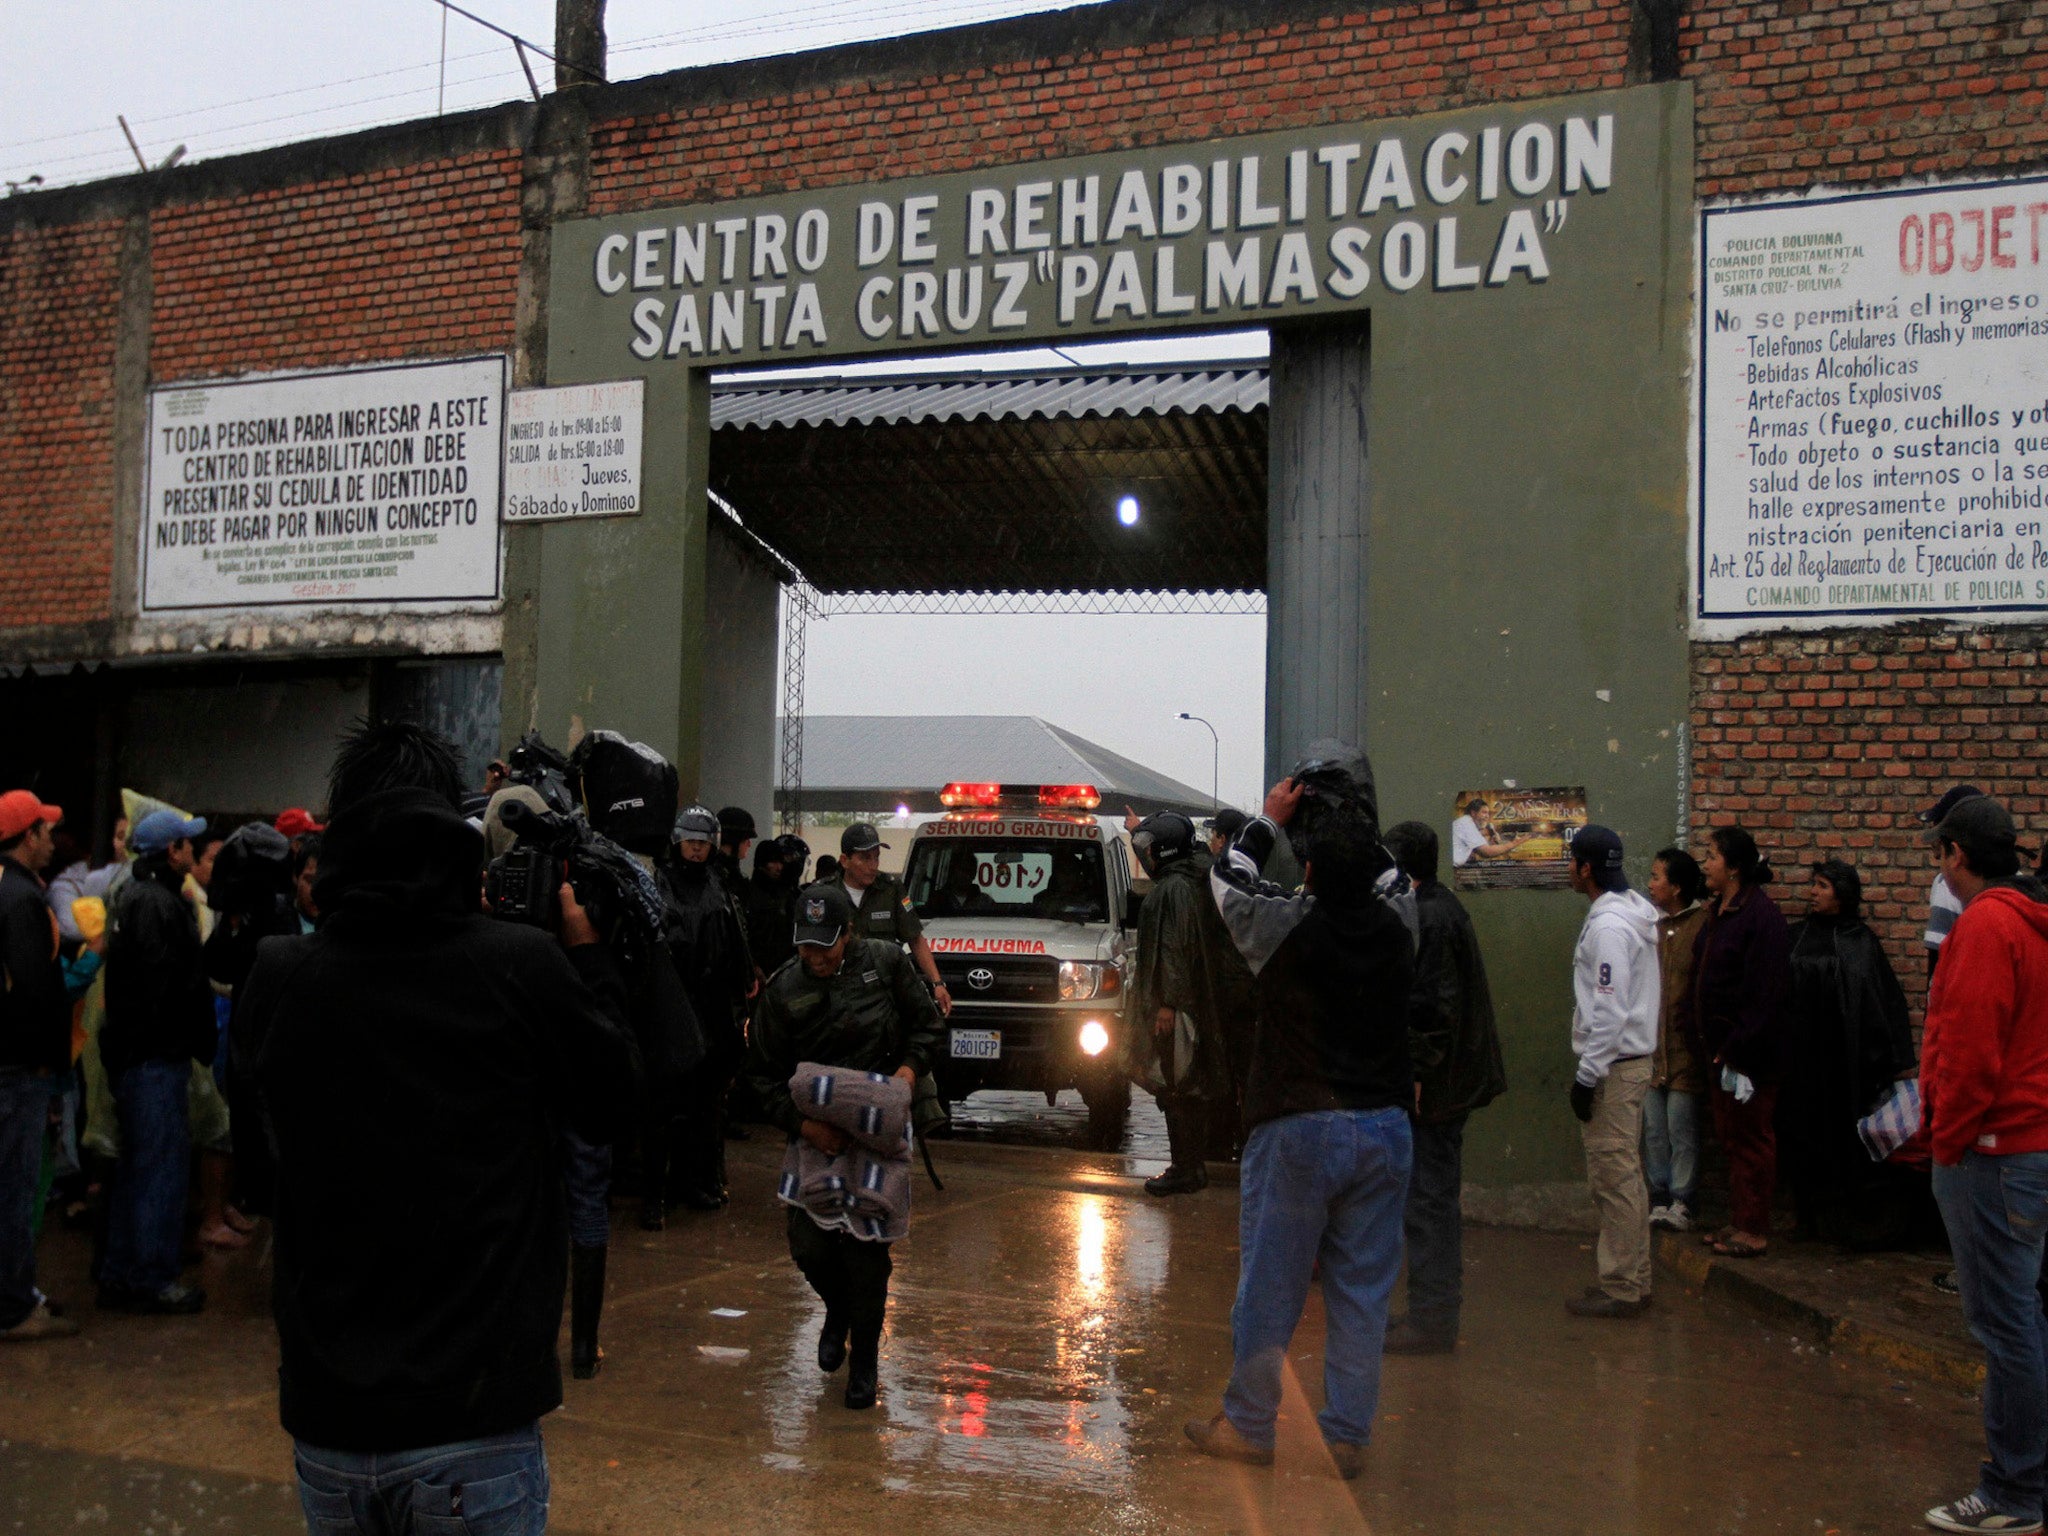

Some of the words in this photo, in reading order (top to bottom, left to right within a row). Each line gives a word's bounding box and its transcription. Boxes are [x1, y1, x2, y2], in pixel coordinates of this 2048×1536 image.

[596, 208, 829, 294] CENTRO
[858, 196, 938, 268] DE
[968, 115, 1613, 257] REHABILITACION
[1709, 254, 1764, 269] COMANDO
[1770, 246, 1865, 265] DEPARTAMENTAL
[1727, 238, 1776, 252] POLICIA
[1782, 232, 1843, 249] BOLIVIANA
[1714, 268, 1763, 284] DISTRITO
[1768, 264, 1812, 279] POLICIAL
[1841, 262, 1849, 274] 2
[1723, 282, 1757, 297] SANTA
[1797, 277, 1842, 293] BOLIVIA
[630, 282, 827, 358] SANTA
[857, 261, 1029, 339] CRUZ
[1714, 309, 1741, 333] No
[1755, 311, 1784, 327] se
[1794, 297, 1898, 329] permitirá
[1910, 293, 1930, 318] el
[1940, 293, 2039, 323] ingreso
[1748, 335, 1822, 358] Telefonos
[1829, 328, 1895, 352] Celulares
[1904, 322, 1950, 347] (Flash
[1954, 326, 1965, 347] y
[1747, 364, 1808, 384] Bebidas
[1816, 354, 1919, 380] Alcohólicas
[1748, 387, 1840, 410] Artefactos
[1849, 383, 1942, 409] Explosivos
[162, 425, 211, 455] TODA
[218, 418, 289, 449] PERSONA
[294, 413, 333, 442] PARA
[338, 402, 421, 437] INGRESAR
[428, 402, 442, 430] A
[446, 396, 489, 428] ESTE
[511, 421, 544, 440] INGRESO
[549, 421, 558, 437] de
[595, 423, 600, 433] a
[1748, 416, 1808, 439] Armas
[1904, 406, 2000, 431] cuchillos
[2011, 411, 2024, 429] y
[184, 456, 248, 484] CENTRO
[254, 453, 272, 478] DE
[276, 437, 414, 476] REHABILITACION
[425, 431, 467, 463] DEBE
[509, 444, 540, 463] SALIDA
[548, 444, 558, 460] de
[597, 446, 601, 457] a
[1748, 443, 1788, 467] Todo
[1798, 440, 1859, 467] objeto
[1872, 446, 1883, 460] o
[1894, 434, 2000, 459] sustancia
[162, 485, 249, 515] PRESENTAR
[254, 482, 273, 508] SU
[279, 477, 341, 506] CEDULA
[346, 475, 365, 500] DE
[372, 466, 468, 499] IDENTIDAD
[1749, 470, 1799, 493] salud
[1808, 470, 1829, 490] de
[1836, 467, 1863, 489] los
[1874, 466, 1960, 488] internos
[1972, 467, 1984, 482] o
[1995, 459, 2013, 481] la
[509, 494, 568, 516] Sábado
[572, 503, 579, 515] y
[1749, 497, 1792, 520] halle
[1802, 491, 1946, 521] expresamente
[157, 521, 179, 549] NO
[182, 517, 217, 545] DEBE
[223, 512, 271, 542] PAGAR
[277, 511, 308, 539] POR
[315, 506, 379, 536] NINGUN
[387, 498, 477, 530] CONCEPTO
[1748, 522, 1851, 546] nistración
[1864, 518, 2003, 551] penitenciaria
[2016, 521, 2040, 537] en
[1709, 553, 1739, 578] Art.
[1745, 551, 1764, 577] 25
[1771, 552, 1792, 576] del
[1798, 550, 1881, 582] Reglamento
[1888, 550, 1906, 574] de
[1916, 544, 1996, 577] Ejecución
[2006, 543, 2024, 570] de
[1746, 586, 1820, 606] COMANDO
[1828, 583, 1934, 604] DEPARTAMENTAL
[1944, 582, 1959, 601] DE
[1969, 580, 2024, 601] POLICIA
[925, 821, 1006, 835] SERVICIO
[1011, 823, 1098, 839] GRATUITO
[1599, 963, 1612, 986] 9
